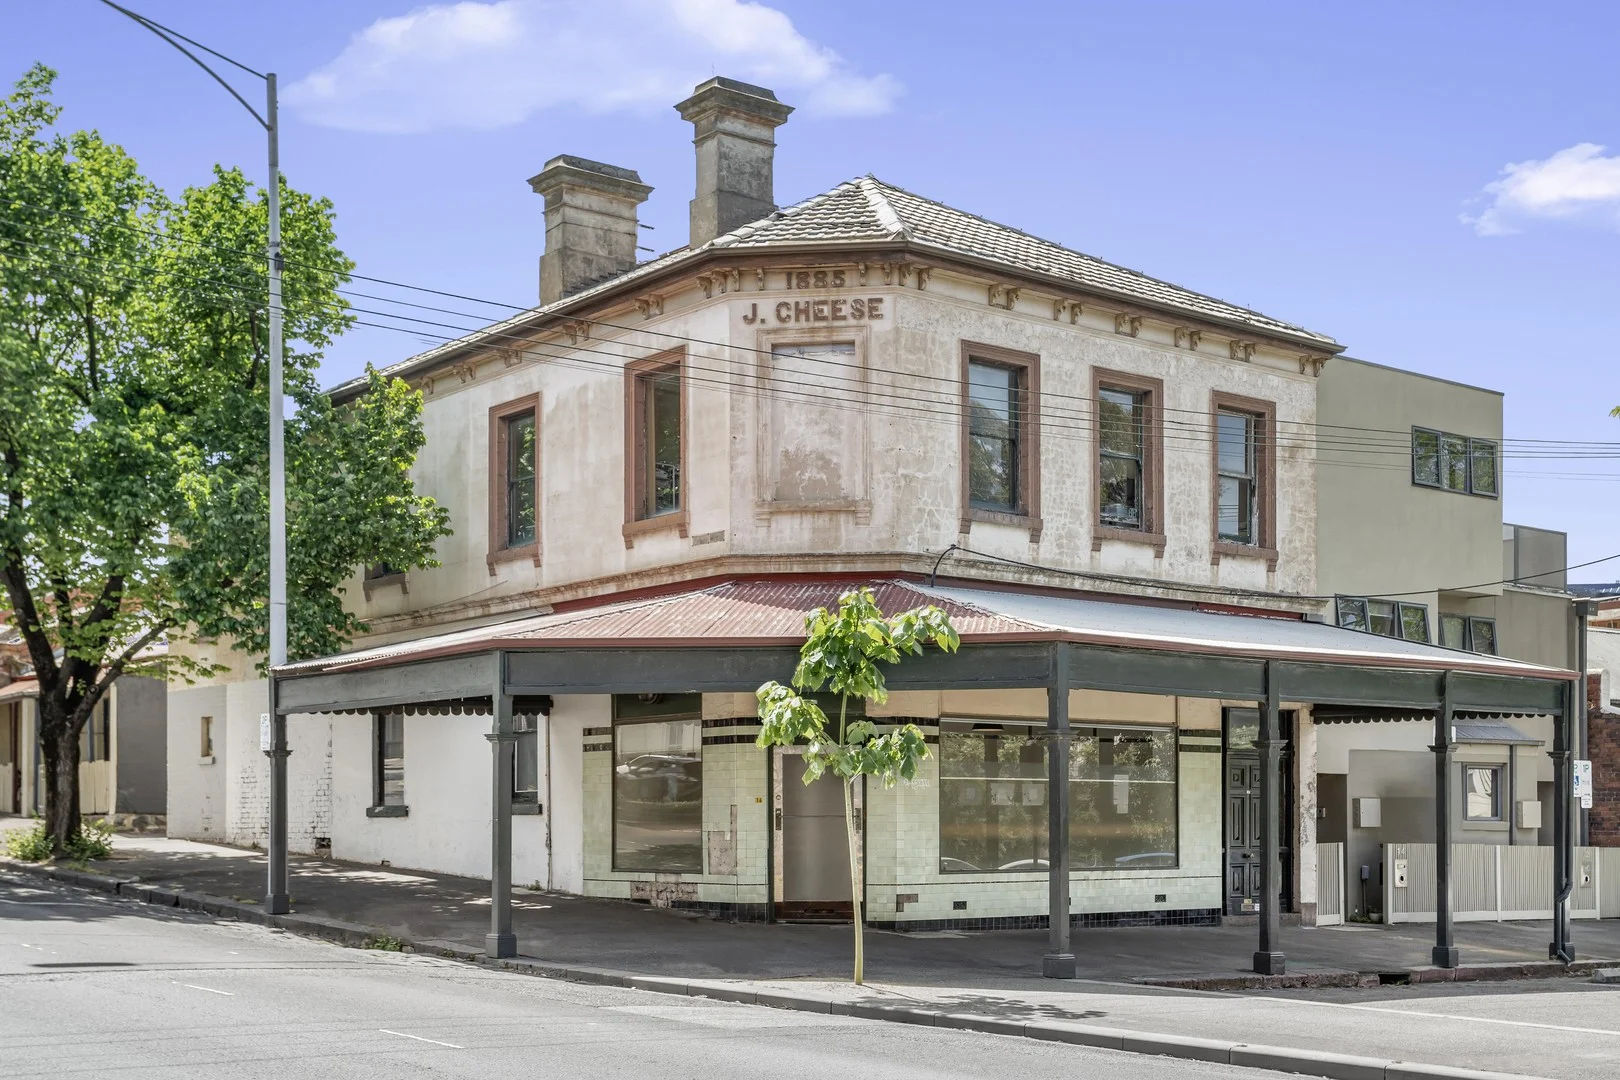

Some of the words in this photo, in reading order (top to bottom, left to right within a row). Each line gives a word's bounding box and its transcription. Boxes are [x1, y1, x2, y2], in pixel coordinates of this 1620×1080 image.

[786, 270, 846, 289] 1885
[742, 303, 766, 325] J.
[776, 297, 884, 323] CHEESE
